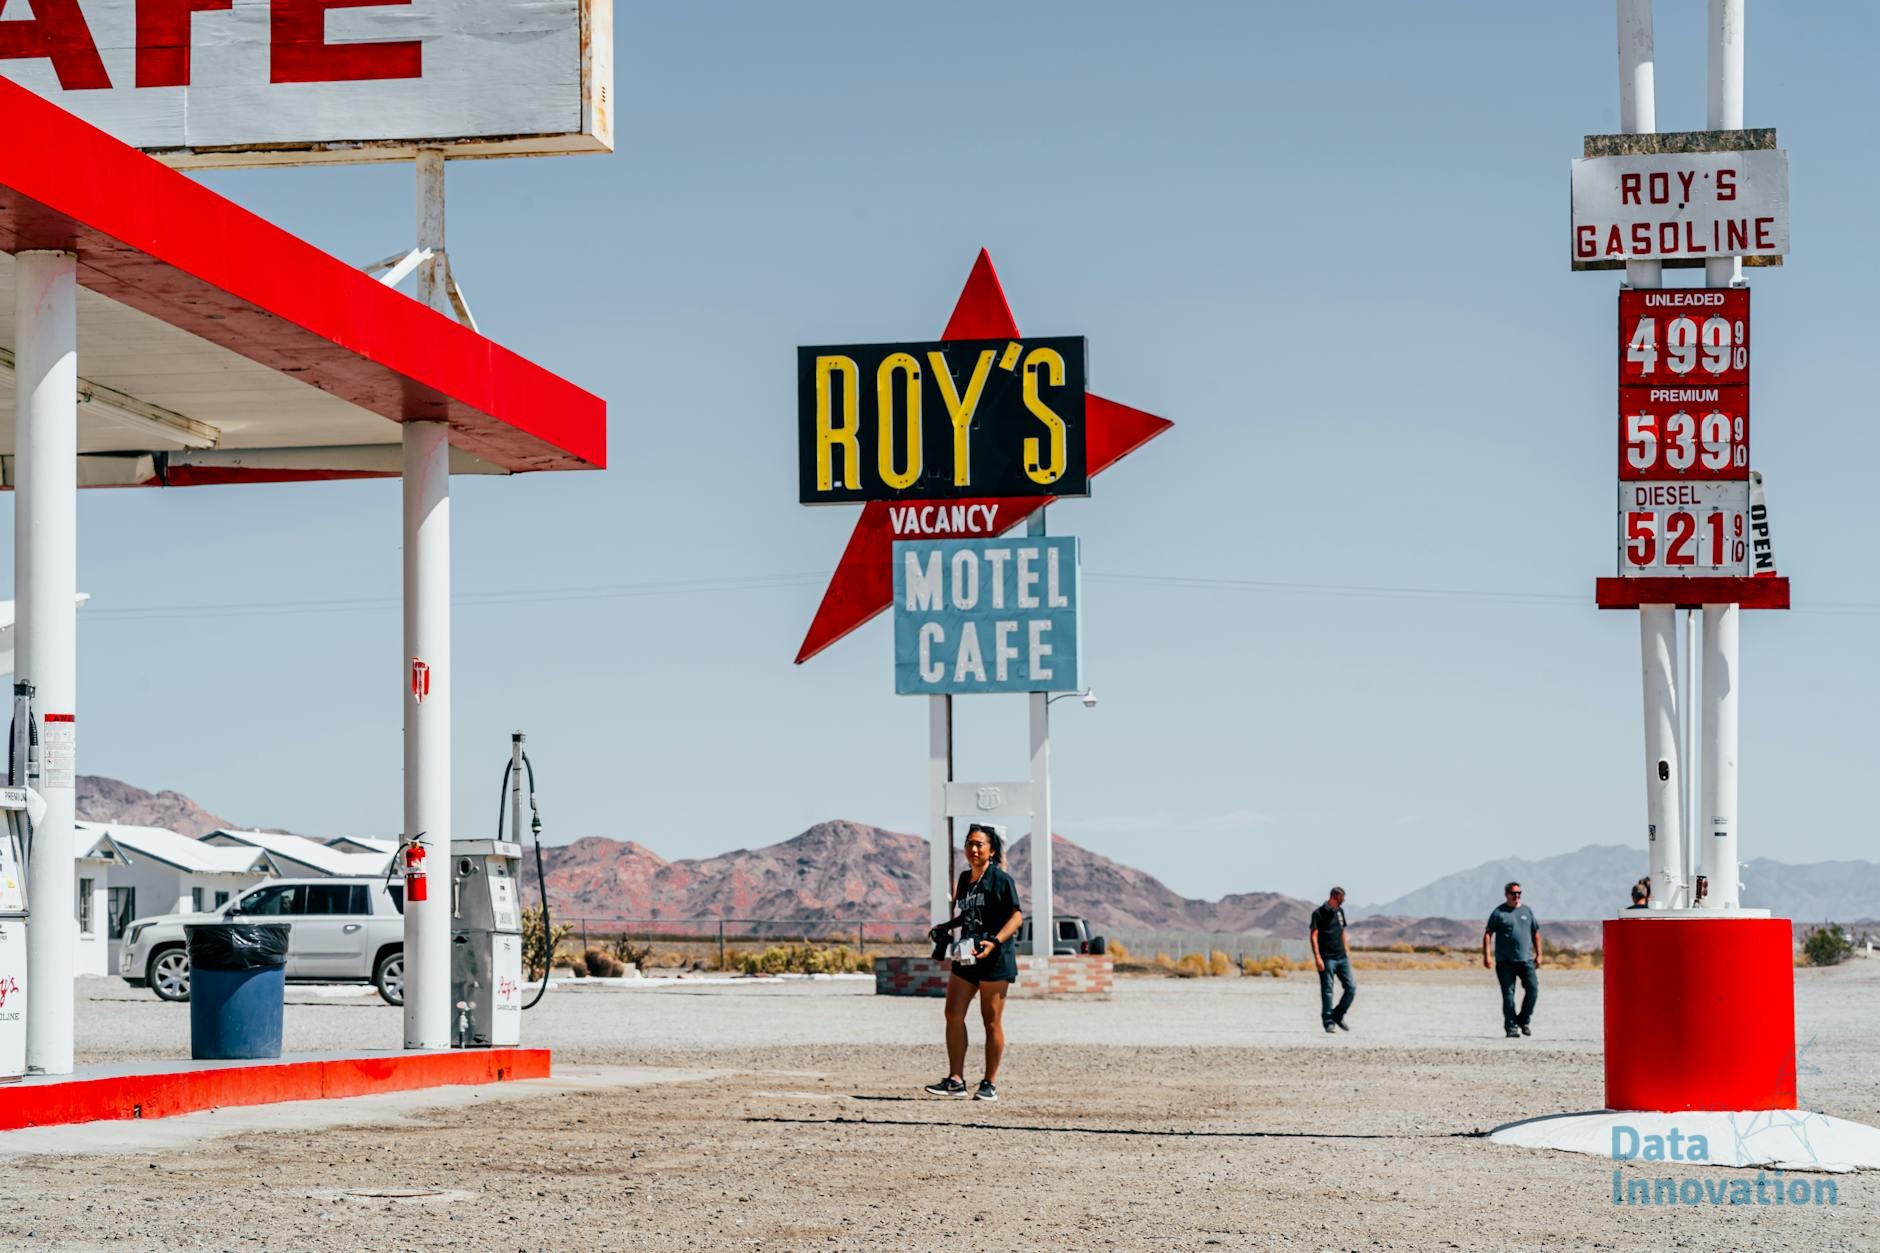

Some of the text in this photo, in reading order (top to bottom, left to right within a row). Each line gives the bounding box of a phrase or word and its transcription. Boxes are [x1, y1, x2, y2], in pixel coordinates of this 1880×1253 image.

[1621, 170, 1737, 205] ROY'S
[1576, 217, 1776, 258] GASOLINE
[1645, 293, 1725, 306] UNLEADED
[1626, 317, 1732, 374] 499
[1734, 320, 1744, 344] 9
[816, 341, 1065, 491] ROY'S
[1650, 389, 1719, 402] PREMIUM
[1627, 413, 1731, 470] 539
[1734, 416, 1744, 440] 9
[889, 504, 999, 534] VACANCY
[1636, 485, 1702, 506] DIESEL
[1627, 511, 1724, 566] 521
[1734, 514, 1743, 537] 9
[1751, 504, 1773, 569] OPEN
[905, 547, 1067, 611] MOTEL
[919, 620, 1053, 683] CAFE
